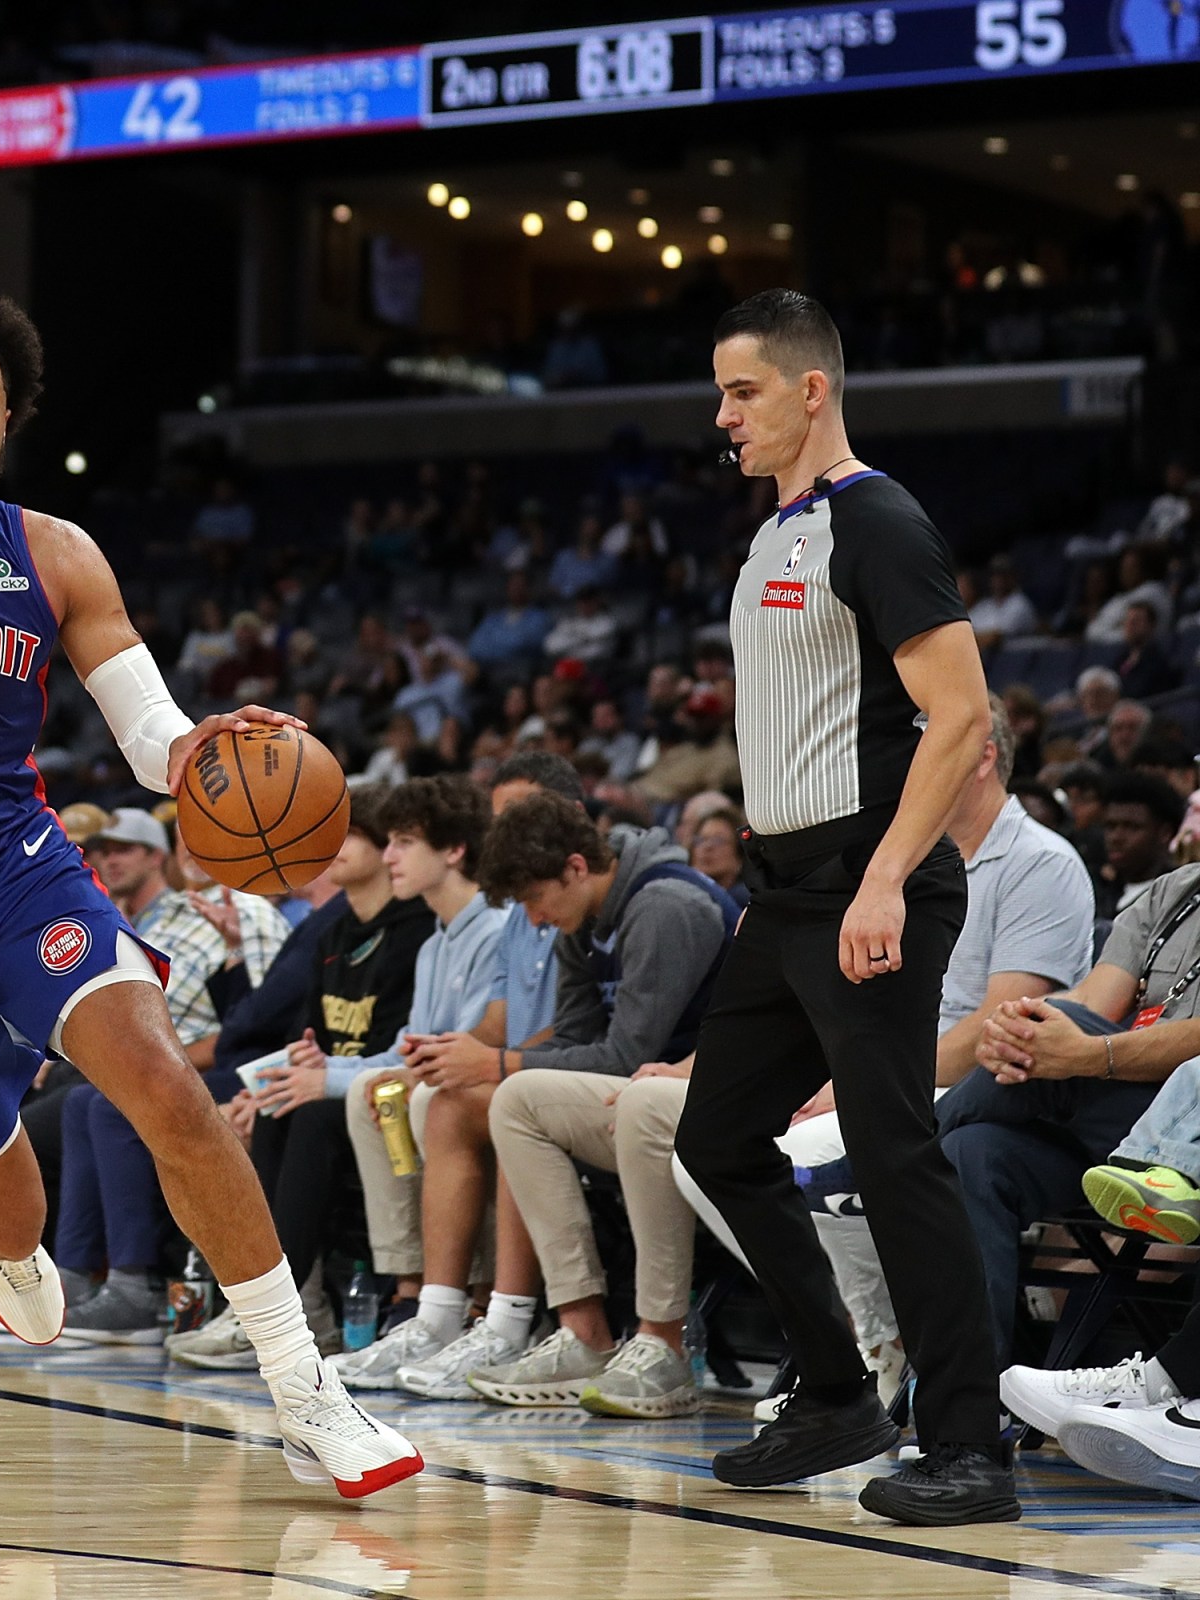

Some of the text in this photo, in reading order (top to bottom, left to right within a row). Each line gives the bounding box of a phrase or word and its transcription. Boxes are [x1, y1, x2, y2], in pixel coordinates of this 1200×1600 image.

[975, 0, 1066, 70] 55
[576, 34, 674, 102] 6:08
[122, 77, 204, 144] 42
[762, 586, 804, 603] Emirates
[47, 929, 77, 954] DETROIT
[50, 936, 81, 962] PISTONS
